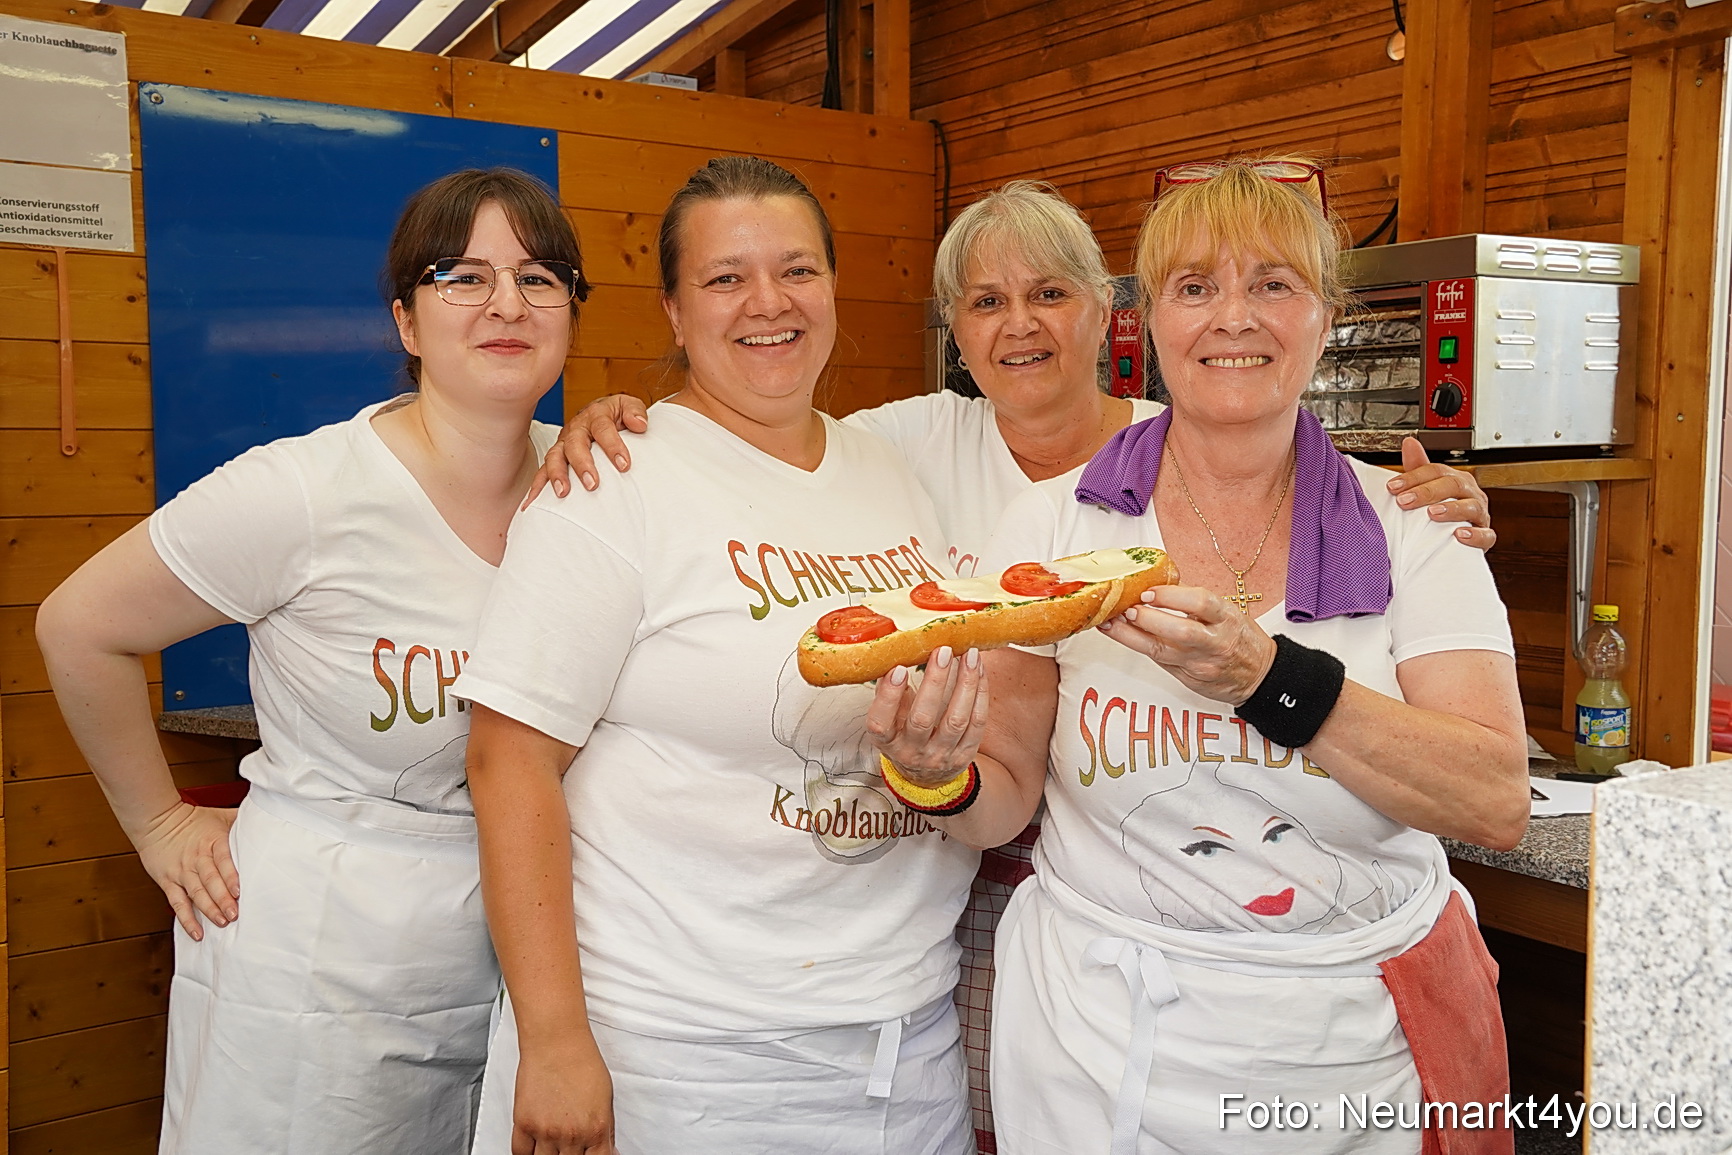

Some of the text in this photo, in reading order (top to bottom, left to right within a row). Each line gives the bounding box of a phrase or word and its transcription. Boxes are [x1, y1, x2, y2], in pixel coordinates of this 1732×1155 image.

[0, 197, 100, 213] onservierungsstoff
[1435, 281, 1465, 310] frifri
[1434, 312, 1466, 321] FRANKE
